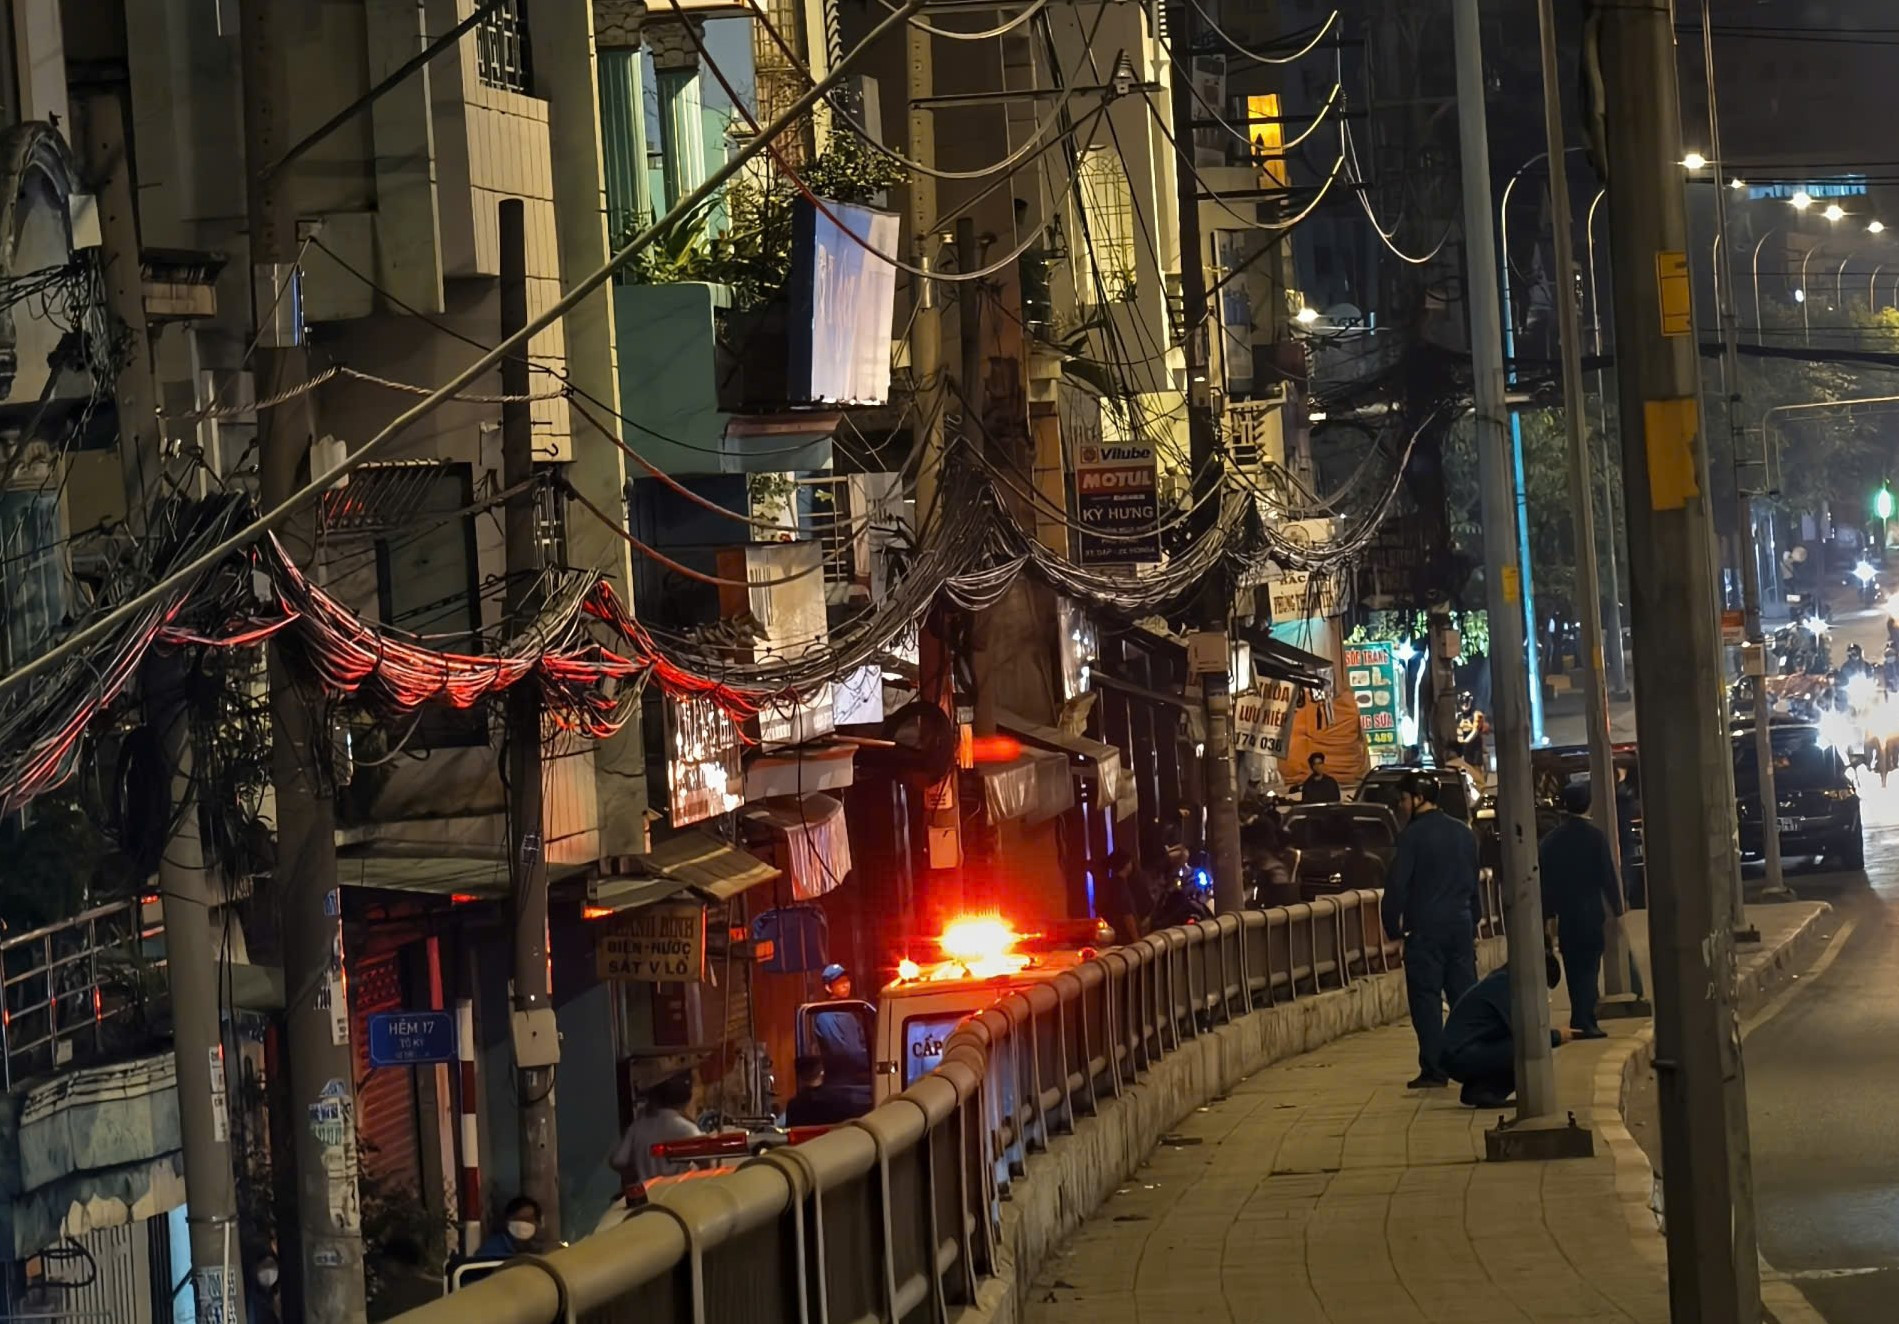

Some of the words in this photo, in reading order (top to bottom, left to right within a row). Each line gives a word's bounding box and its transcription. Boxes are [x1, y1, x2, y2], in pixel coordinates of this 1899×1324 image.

[1101, 447, 1151, 461] Vilube
[1083, 470, 1152, 489] MOTUL
[1108, 506, 1154, 519] HƯNG
[649, 959, 660, 975] V
[423, 1021, 435, 1034] 17
